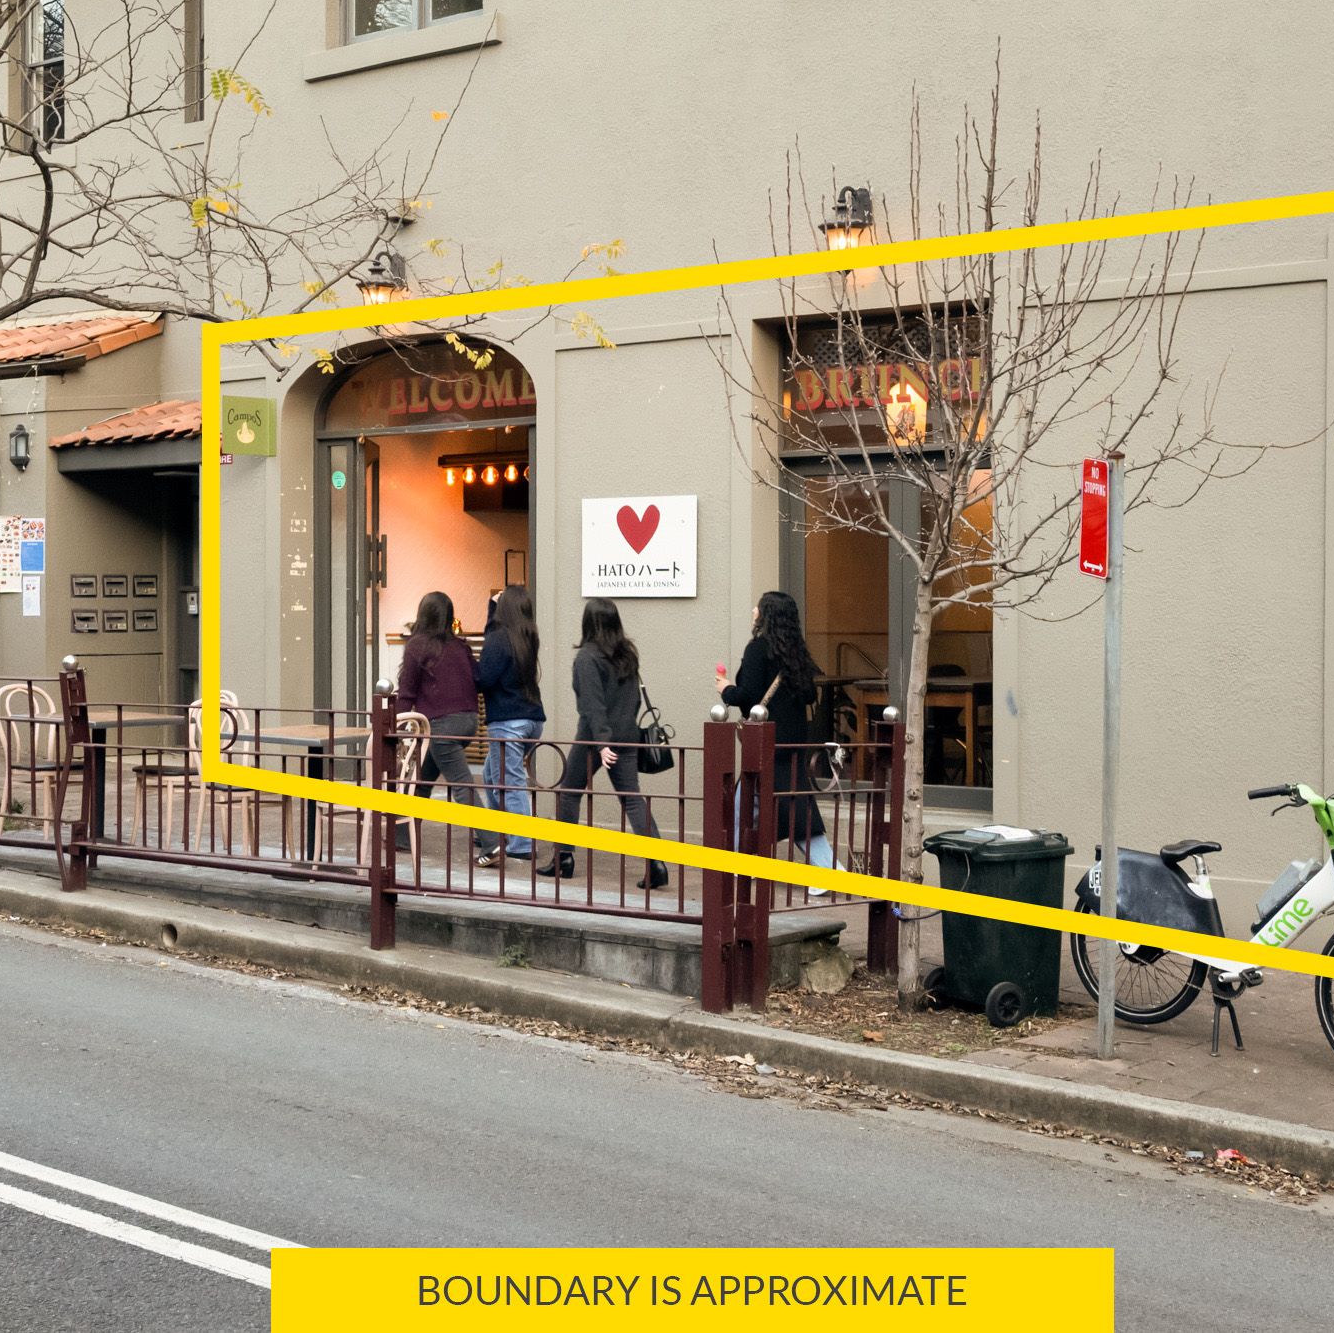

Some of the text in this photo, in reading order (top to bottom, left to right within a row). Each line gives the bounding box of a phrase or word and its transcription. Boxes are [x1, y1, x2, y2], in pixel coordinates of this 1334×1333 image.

[228, 409, 261, 426] Campos
[1091, 467, 1100, 479] NO
[1084, 481, 1106, 497] STOPPING
[598, 561, 680, 579] HATO ハート
[597, 581, 627, 589] JAPANESE
[653, 580, 680, 588] DINING
